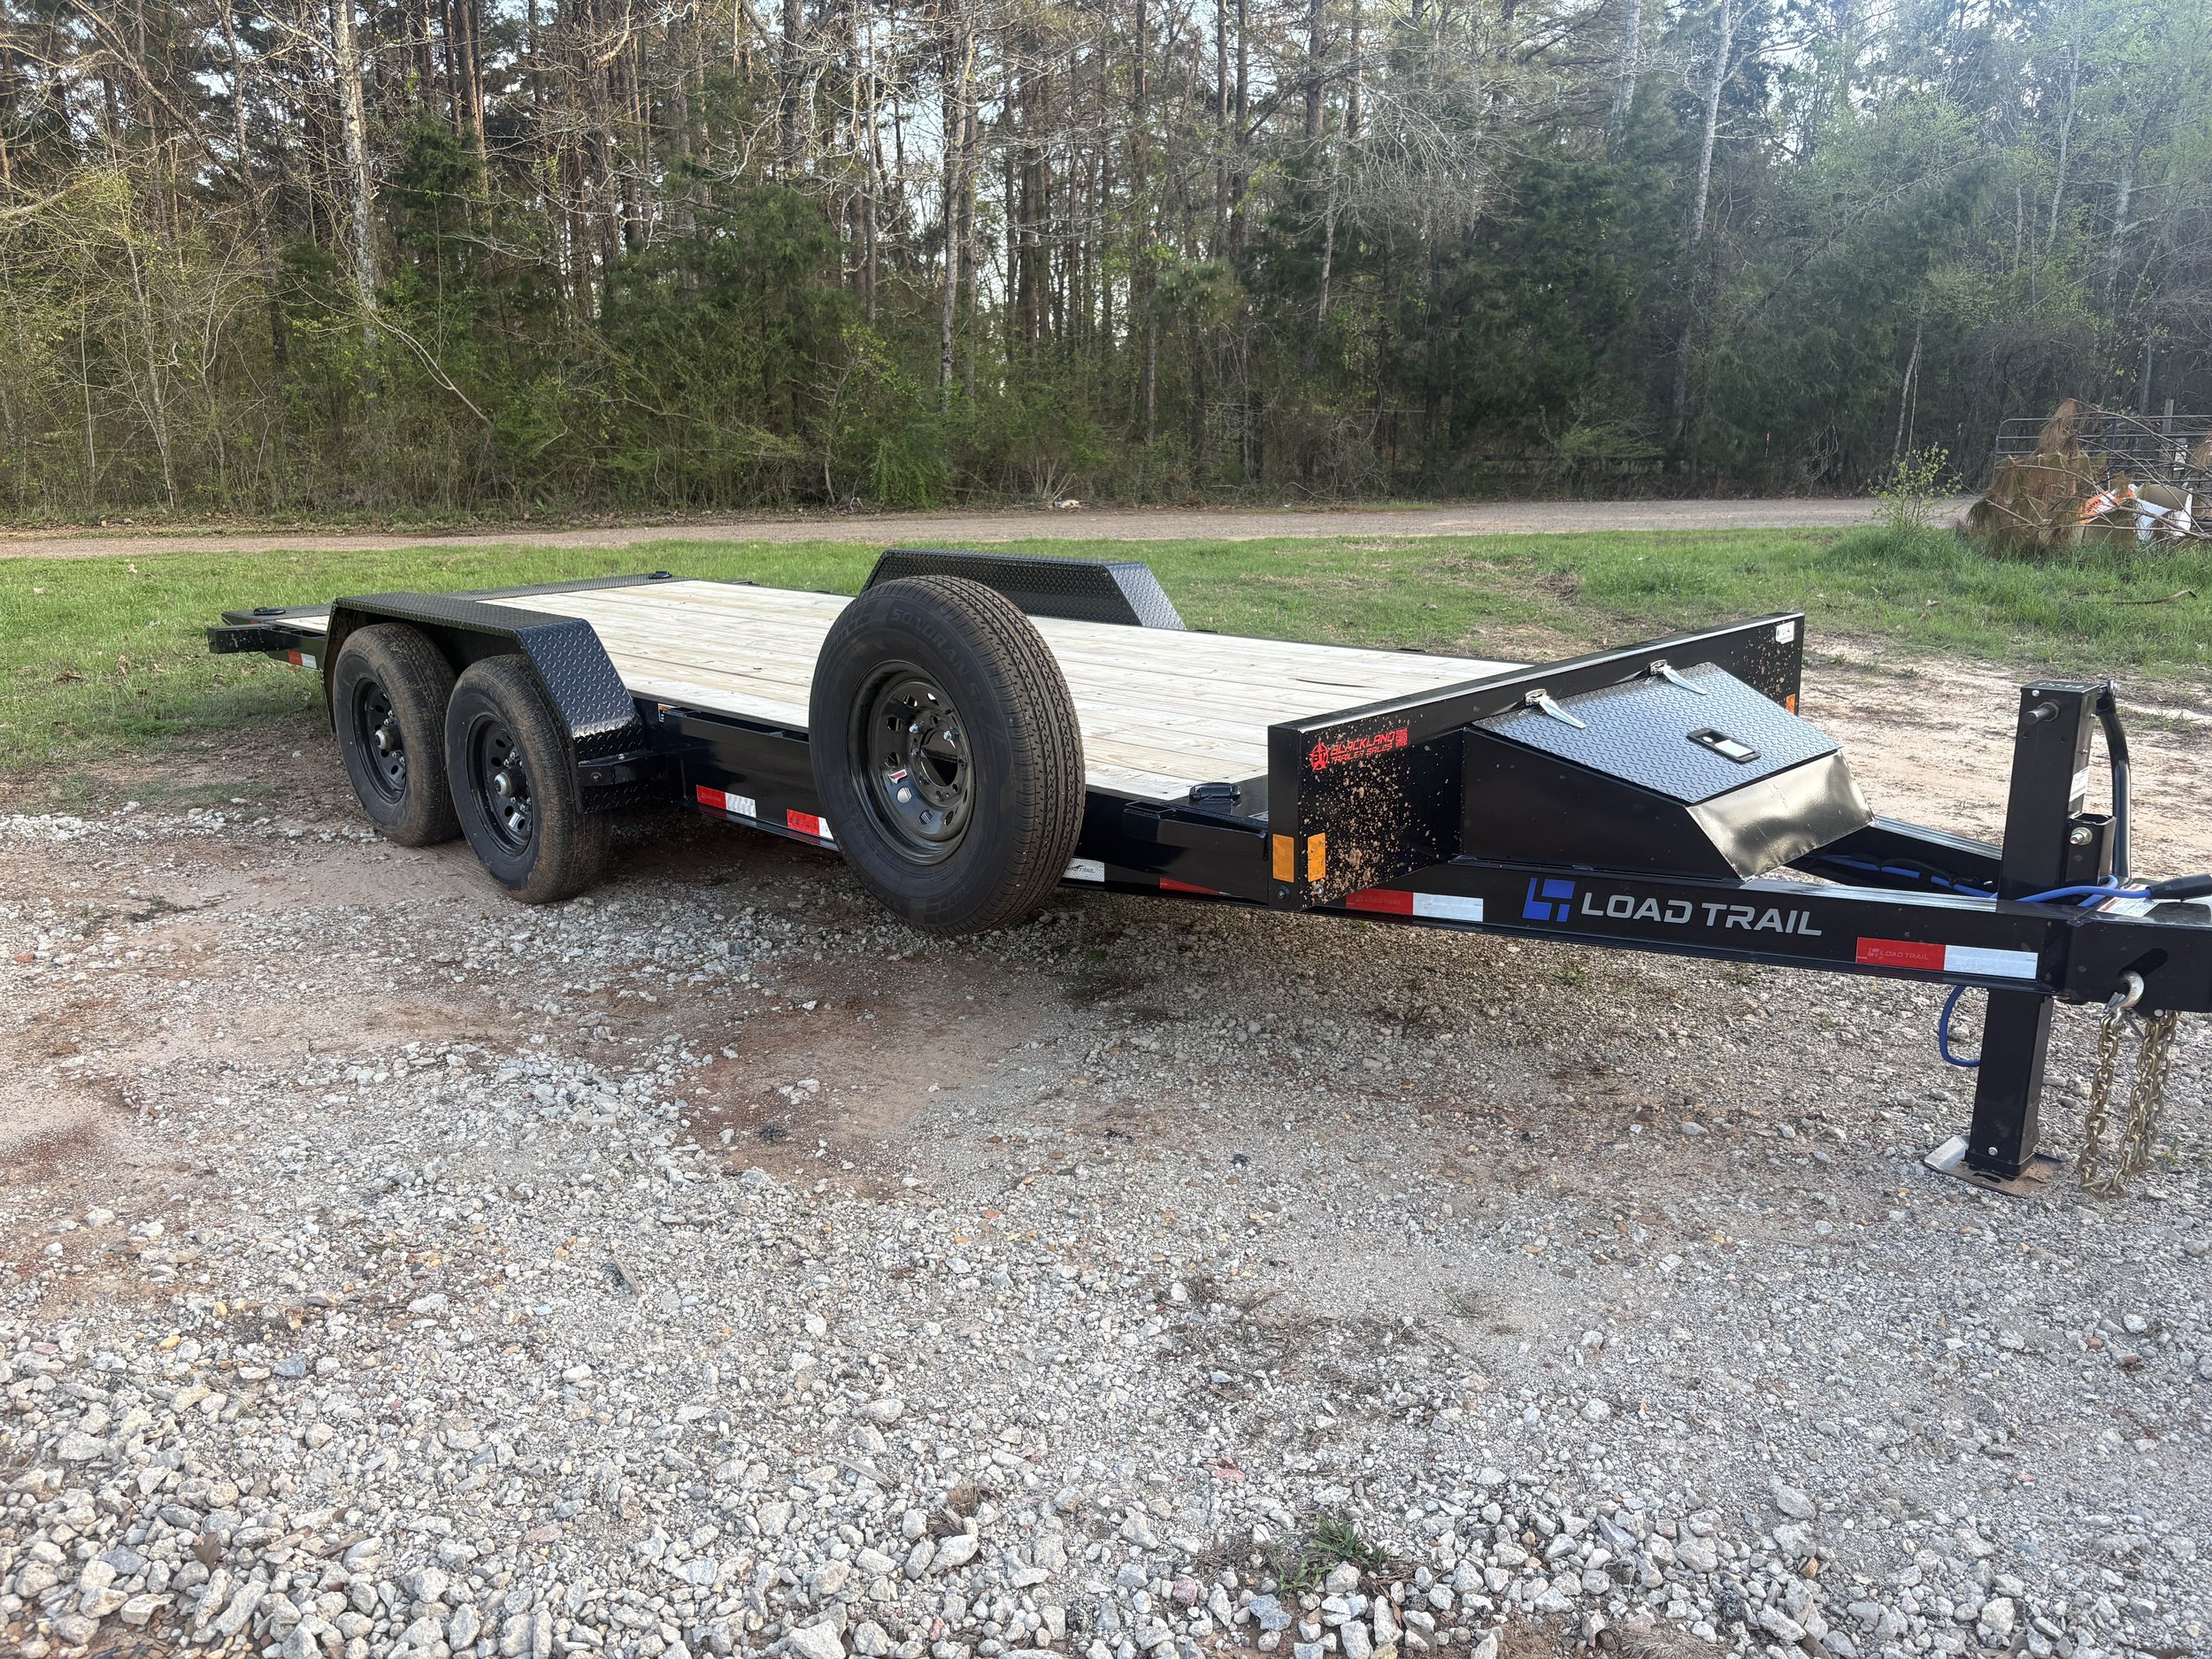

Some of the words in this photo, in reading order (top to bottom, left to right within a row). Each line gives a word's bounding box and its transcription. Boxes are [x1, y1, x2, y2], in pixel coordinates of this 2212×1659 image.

[1330, 731, 1395, 756] BLACKLAND
[1366, 743, 1392, 757] SALES
[1581, 892, 1693, 924] LOAD
[1701, 902, 1822, 936] TRAIL
